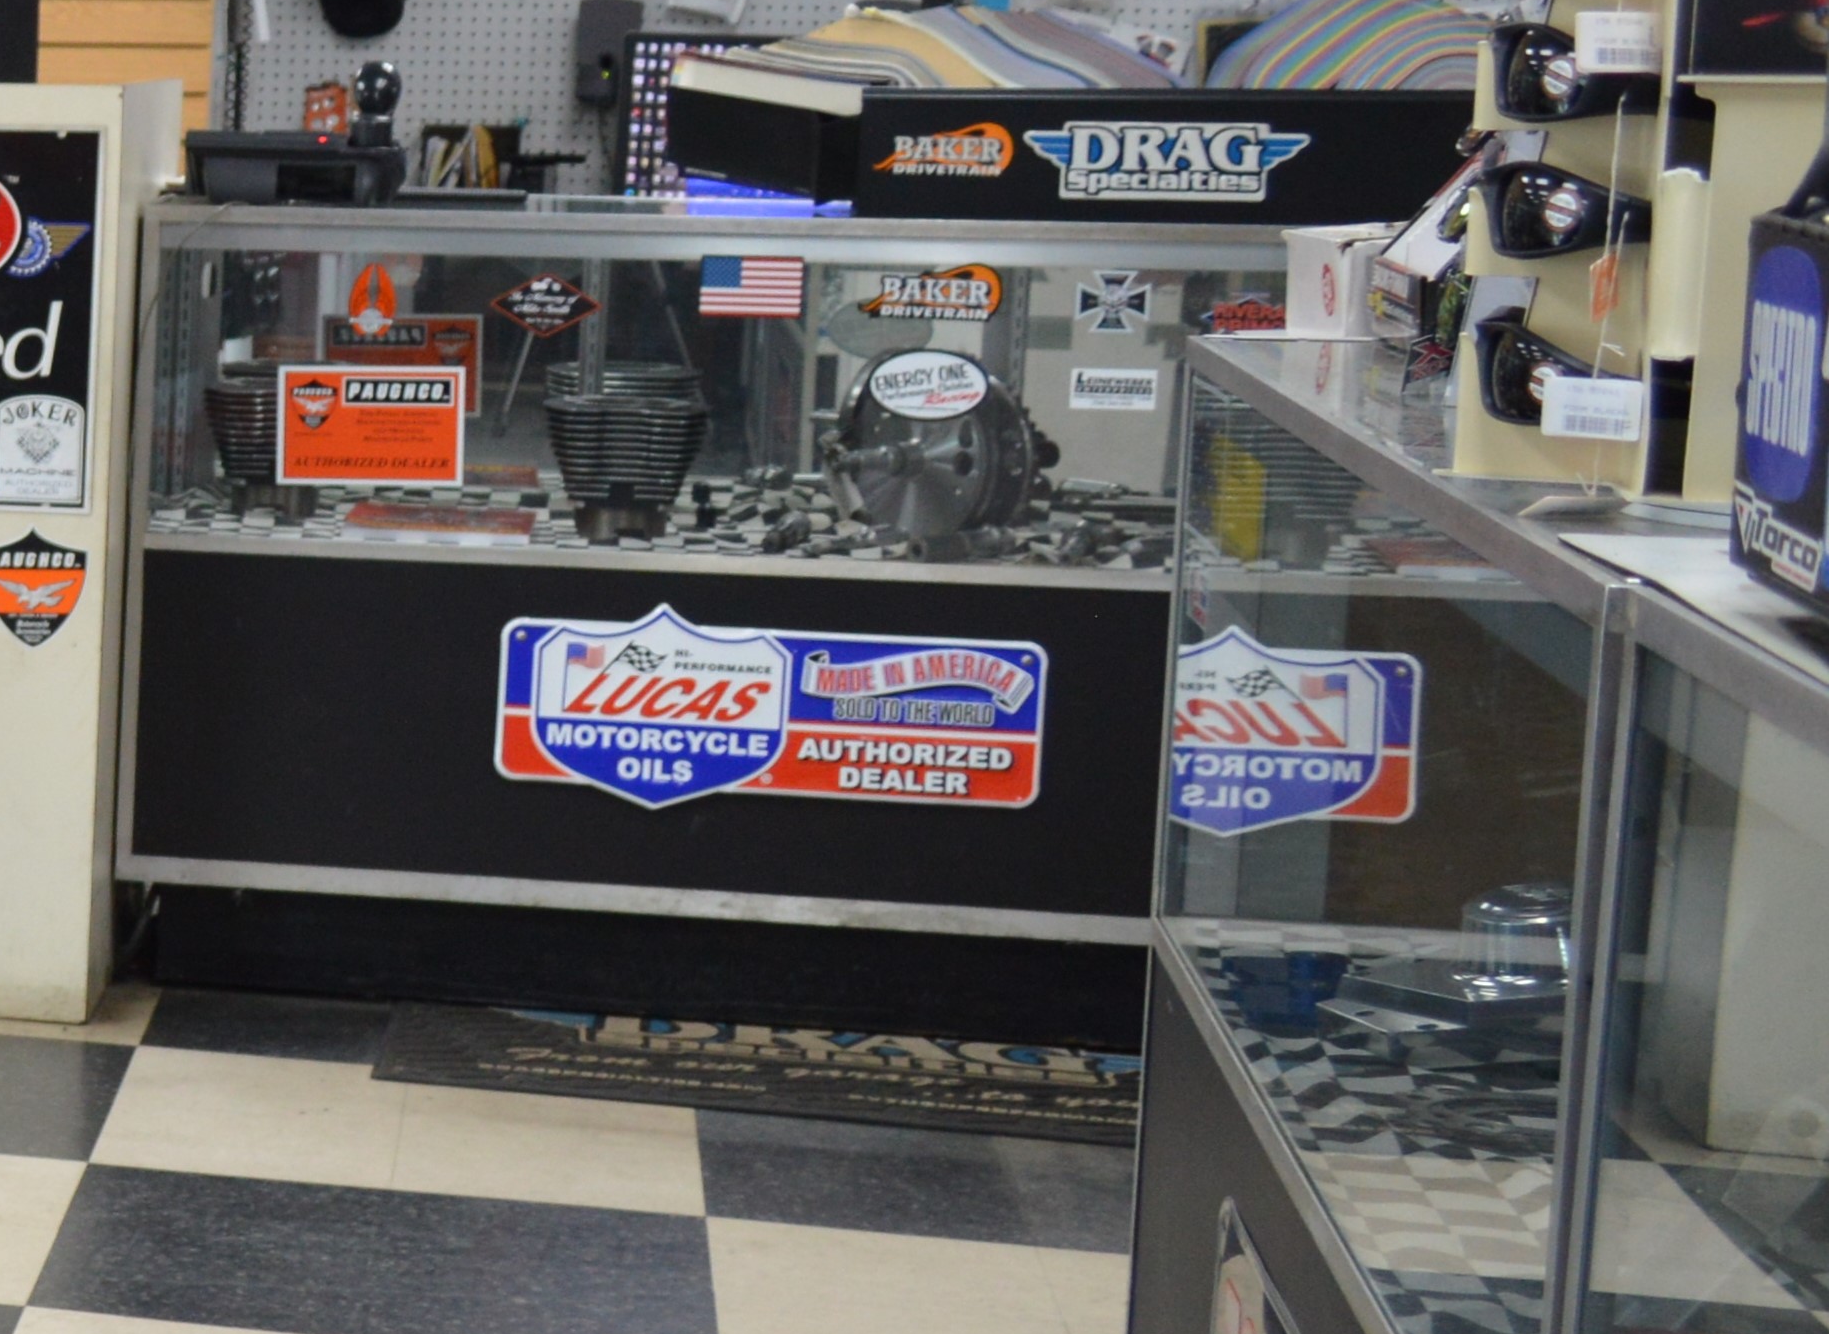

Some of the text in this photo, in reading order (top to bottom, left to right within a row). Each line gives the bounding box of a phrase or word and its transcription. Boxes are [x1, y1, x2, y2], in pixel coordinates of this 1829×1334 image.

[894, 135, 1003, 163] BAKER
[1070, 126, 1264, 173] DRAG
[892, 163, 1003, 177] DRIVETRAIN
[1066, 168, 1262, 195] Specialties
[882, 277, 991, 306] BAKER
[880, 304, 990, 320] DRIVETRAIN
[347, 380, 443, 400] PAUGHCO
[876, 363, 969, 391] ENERGY ONE
[2, 400, 78, 427] JOKER
[294, 456, 450, 468] AUTHORIZED DEALER
[1754, 505, 1819, 572] Torco
[674, 661, 773, 675] PERFORMANCE
[816, 653, 1018, 694] MADE IN AMERICA
[564, 673, 772, 722] LUCAS
[835, 696, 995, 725] SOLD TO THE WORLD
[546, 722, 769, 757] MOTORCYCLE
[797, 738, 1013, 770] AUTHORIZED
[617, 756, 693, 783] OILS
[838, 766, 969, 794] DEALER
